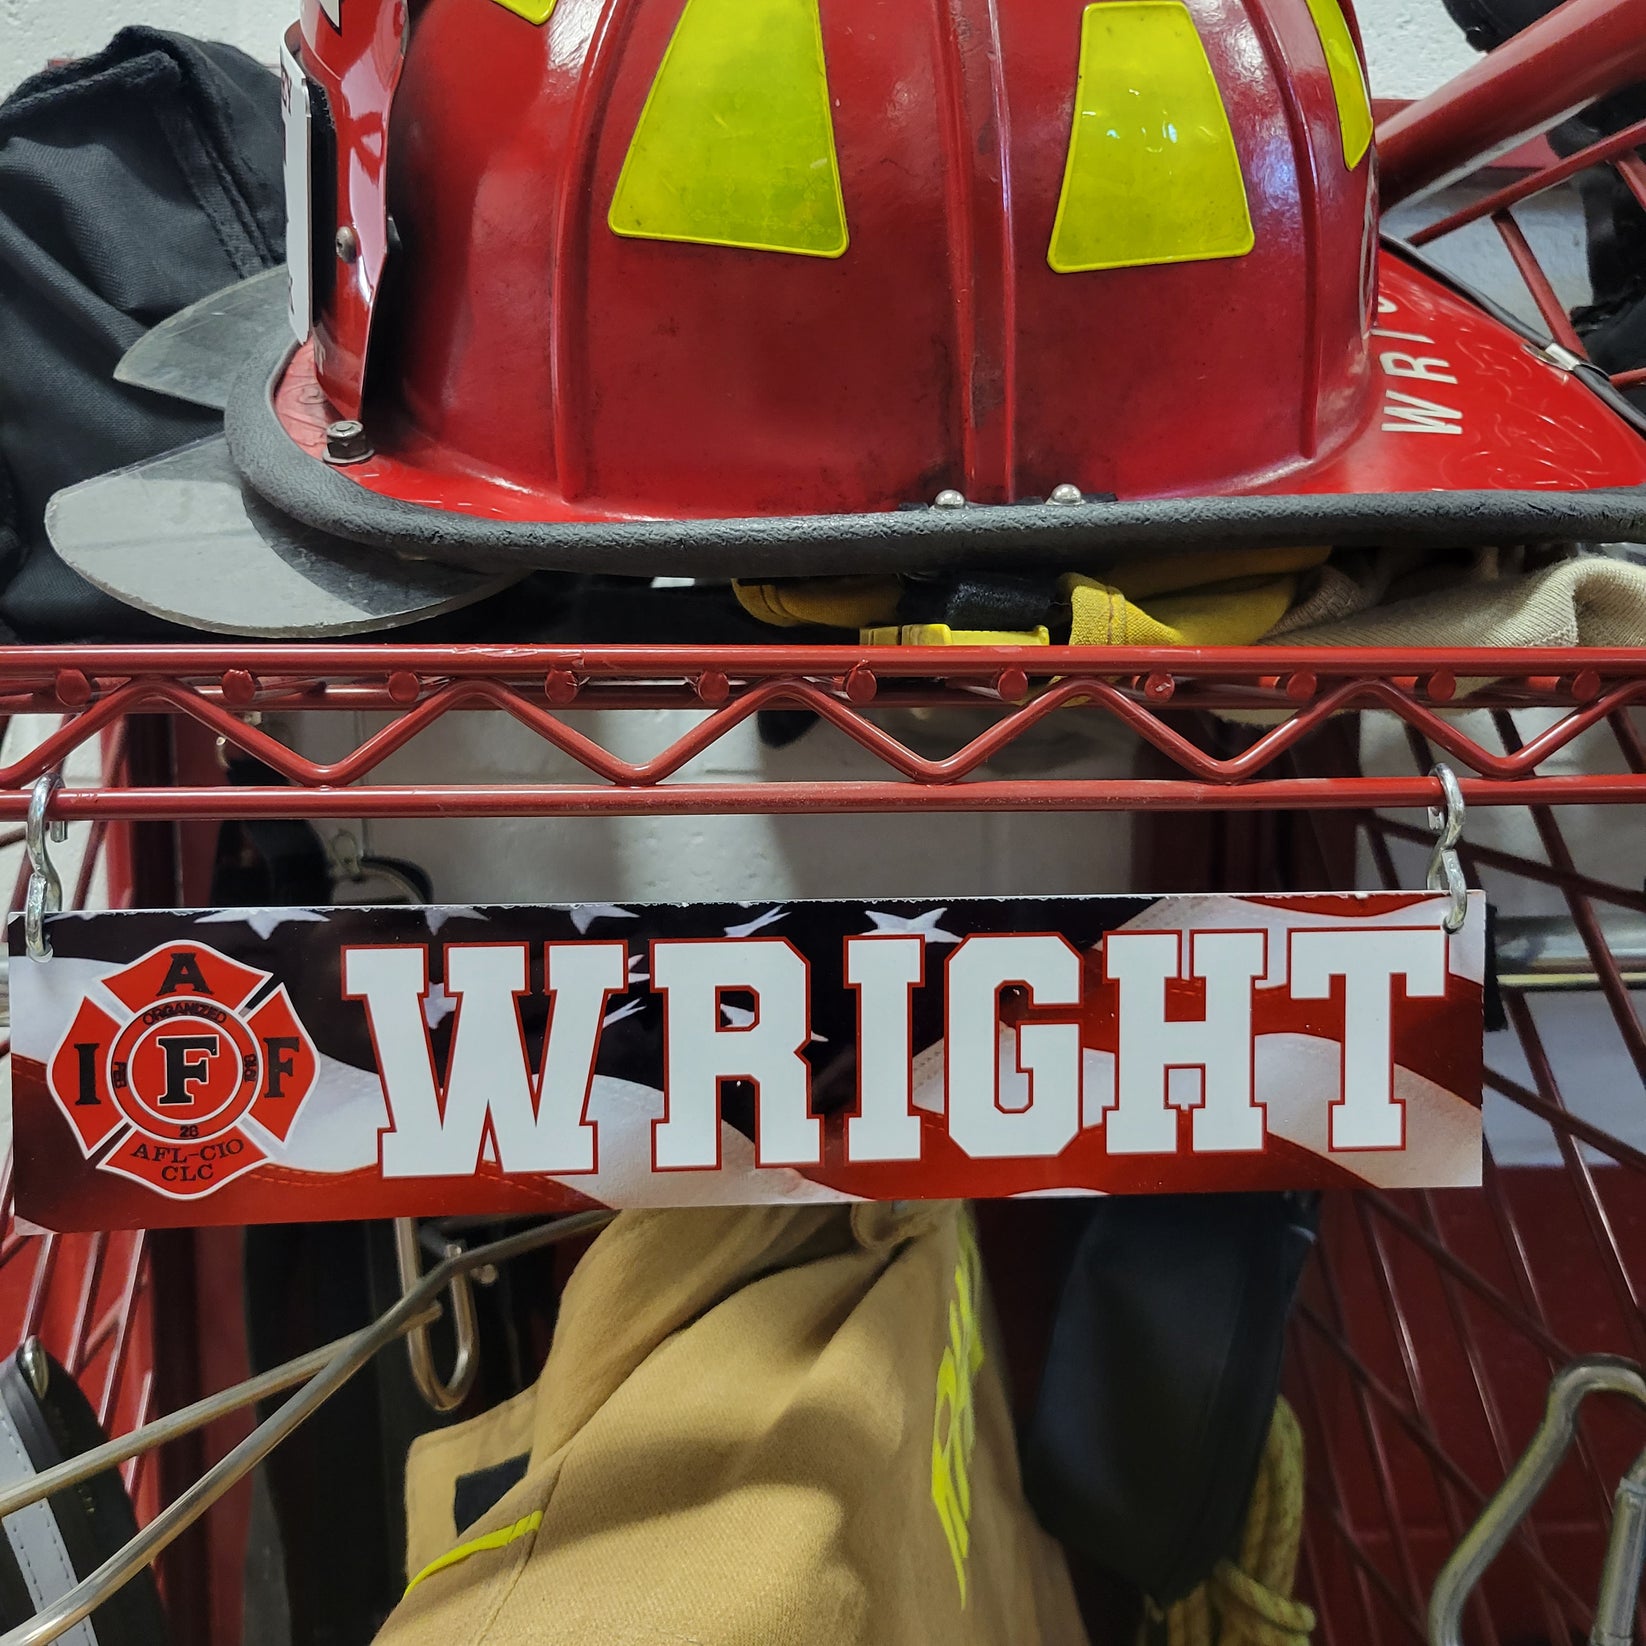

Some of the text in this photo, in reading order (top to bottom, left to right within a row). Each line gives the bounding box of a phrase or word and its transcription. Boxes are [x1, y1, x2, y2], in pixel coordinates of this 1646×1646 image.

[156, 953, 213, 997] A
[74, 1043, 101, 1105] I
[156, 1034, 219, 1106] F
[263, 1036, 300, 1098] F
[340, 926, 1449, 1180] WRIGHT
[131, 1138, 245, 1164] AFL-CIO
[161, 1165, 214, 1182] CLC
